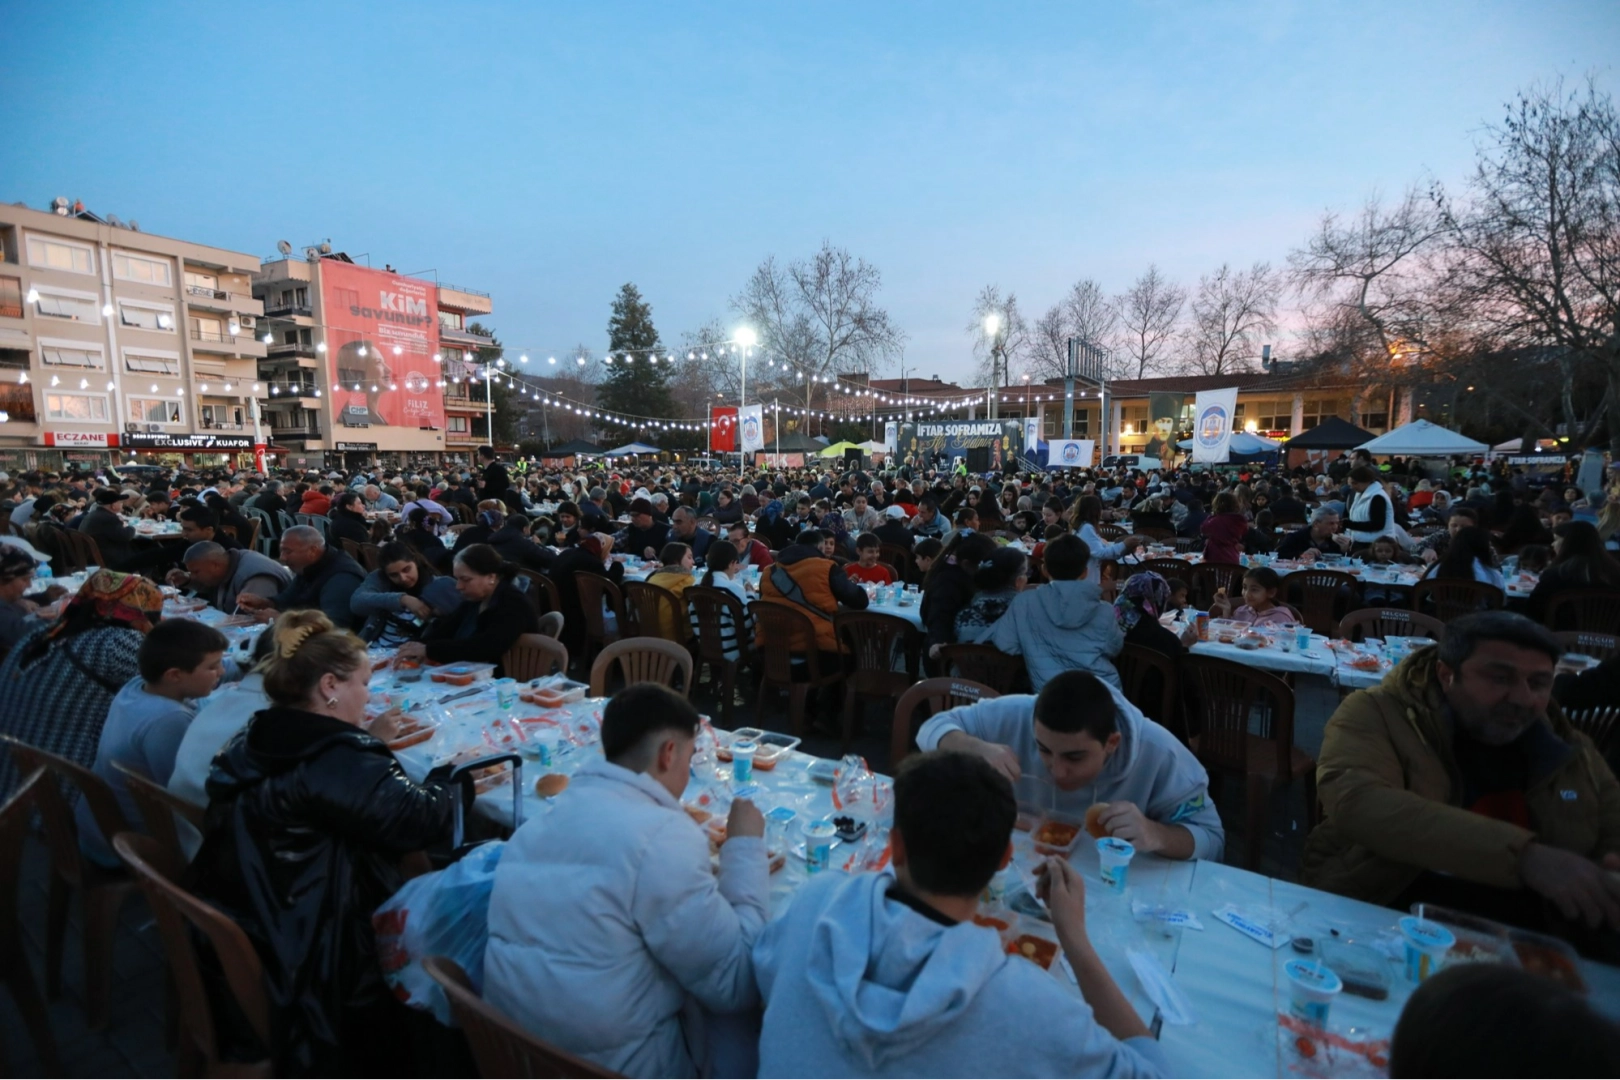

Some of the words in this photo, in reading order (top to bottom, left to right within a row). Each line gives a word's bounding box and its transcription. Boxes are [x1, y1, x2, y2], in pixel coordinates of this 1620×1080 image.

[350, 305, 432, 328] savunur?
[350, 406, 367, 414] CHP
[917, 422, 943, 437] İFTAR
[945, 422, 1002, 436] SOFRAMIZA
[56, 433, 105, 442] ECZANE
[154, 439, 204, 447] EXCLUSIVE
[1381, 610, 1410, 619] SELÇUK
[1577, 634, 1616, 644] SELÇUK
[951, 682, 980, 695] SELÇUK
